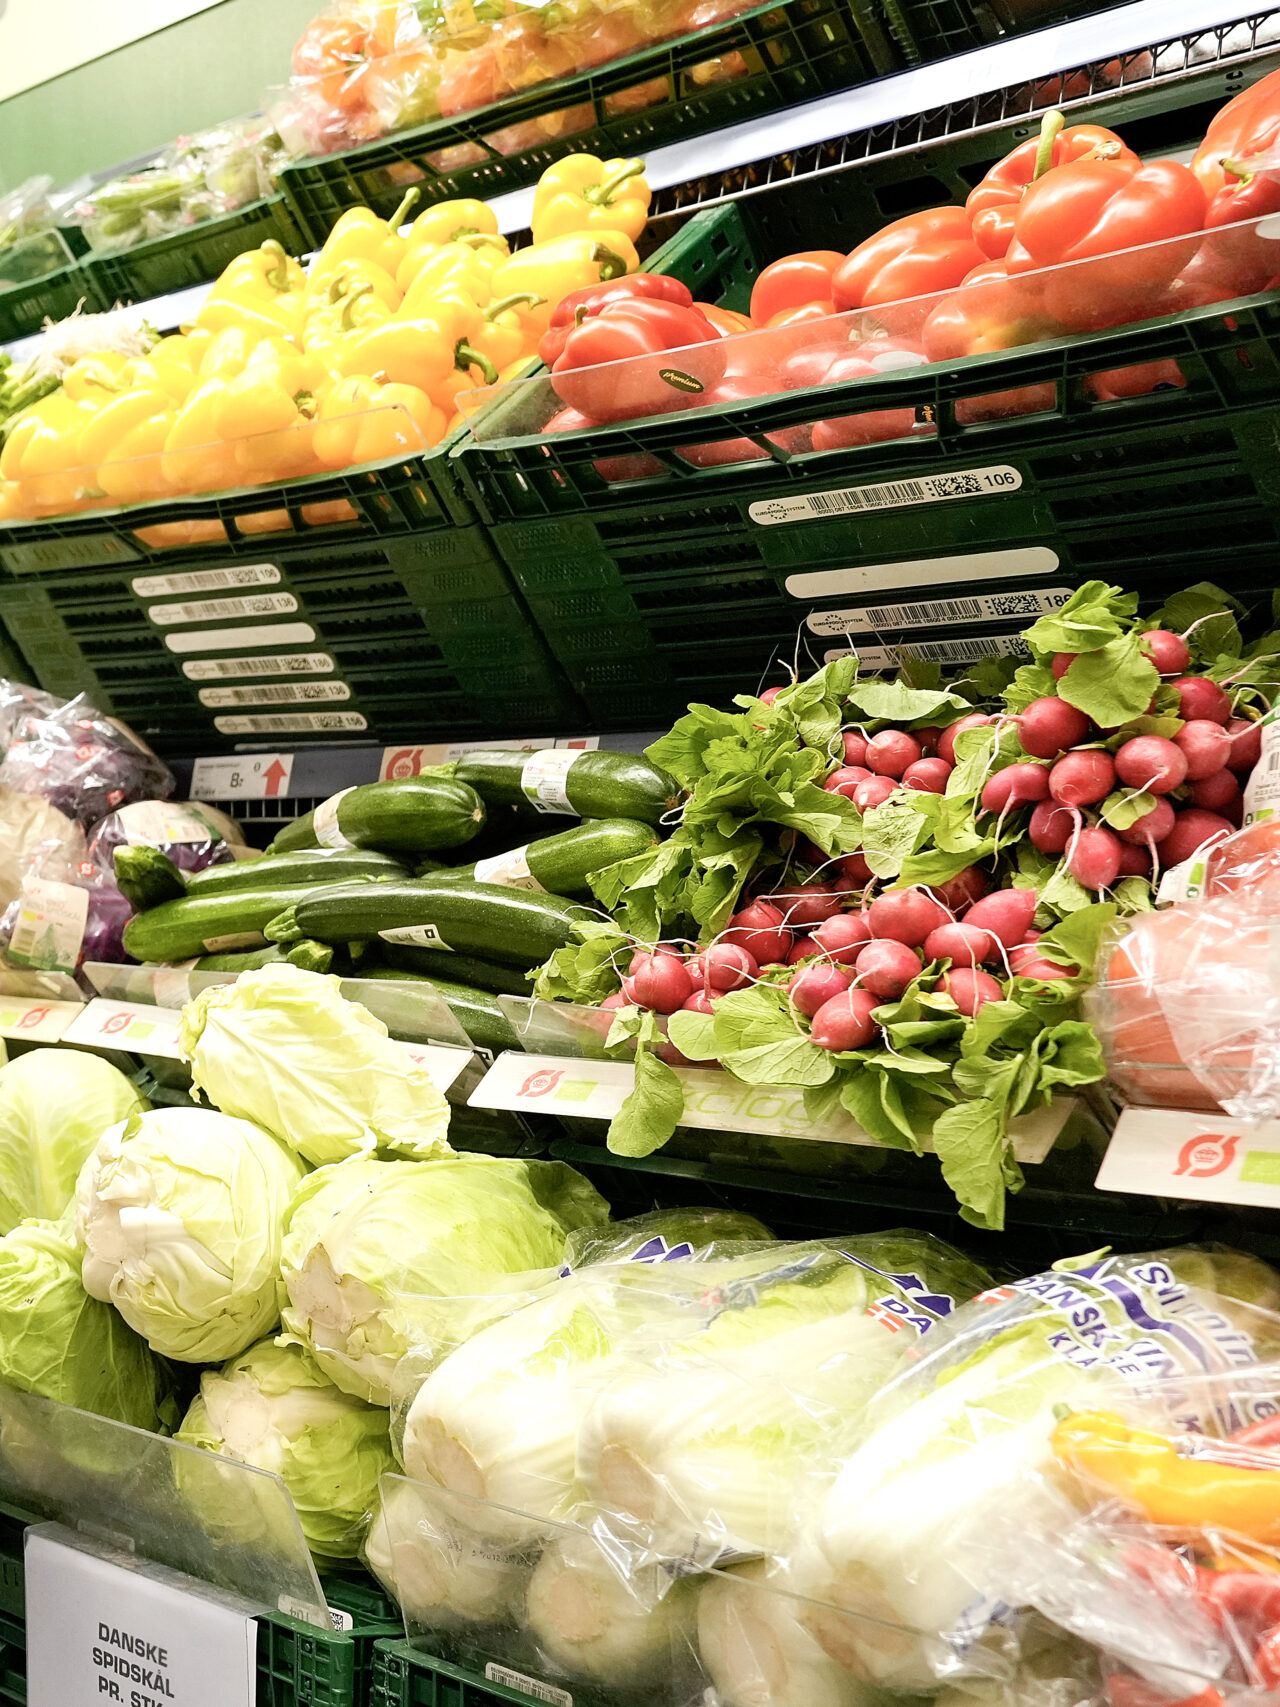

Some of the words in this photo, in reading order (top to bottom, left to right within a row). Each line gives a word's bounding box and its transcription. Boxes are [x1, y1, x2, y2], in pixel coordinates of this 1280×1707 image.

[983, 472, 1015, 488] 106
[99, 1622, 168, 1668] DANSKE
[93, 1647, 175, 1699] SPIDSKÅL
[99, 1675, 124, 1703] PR.
